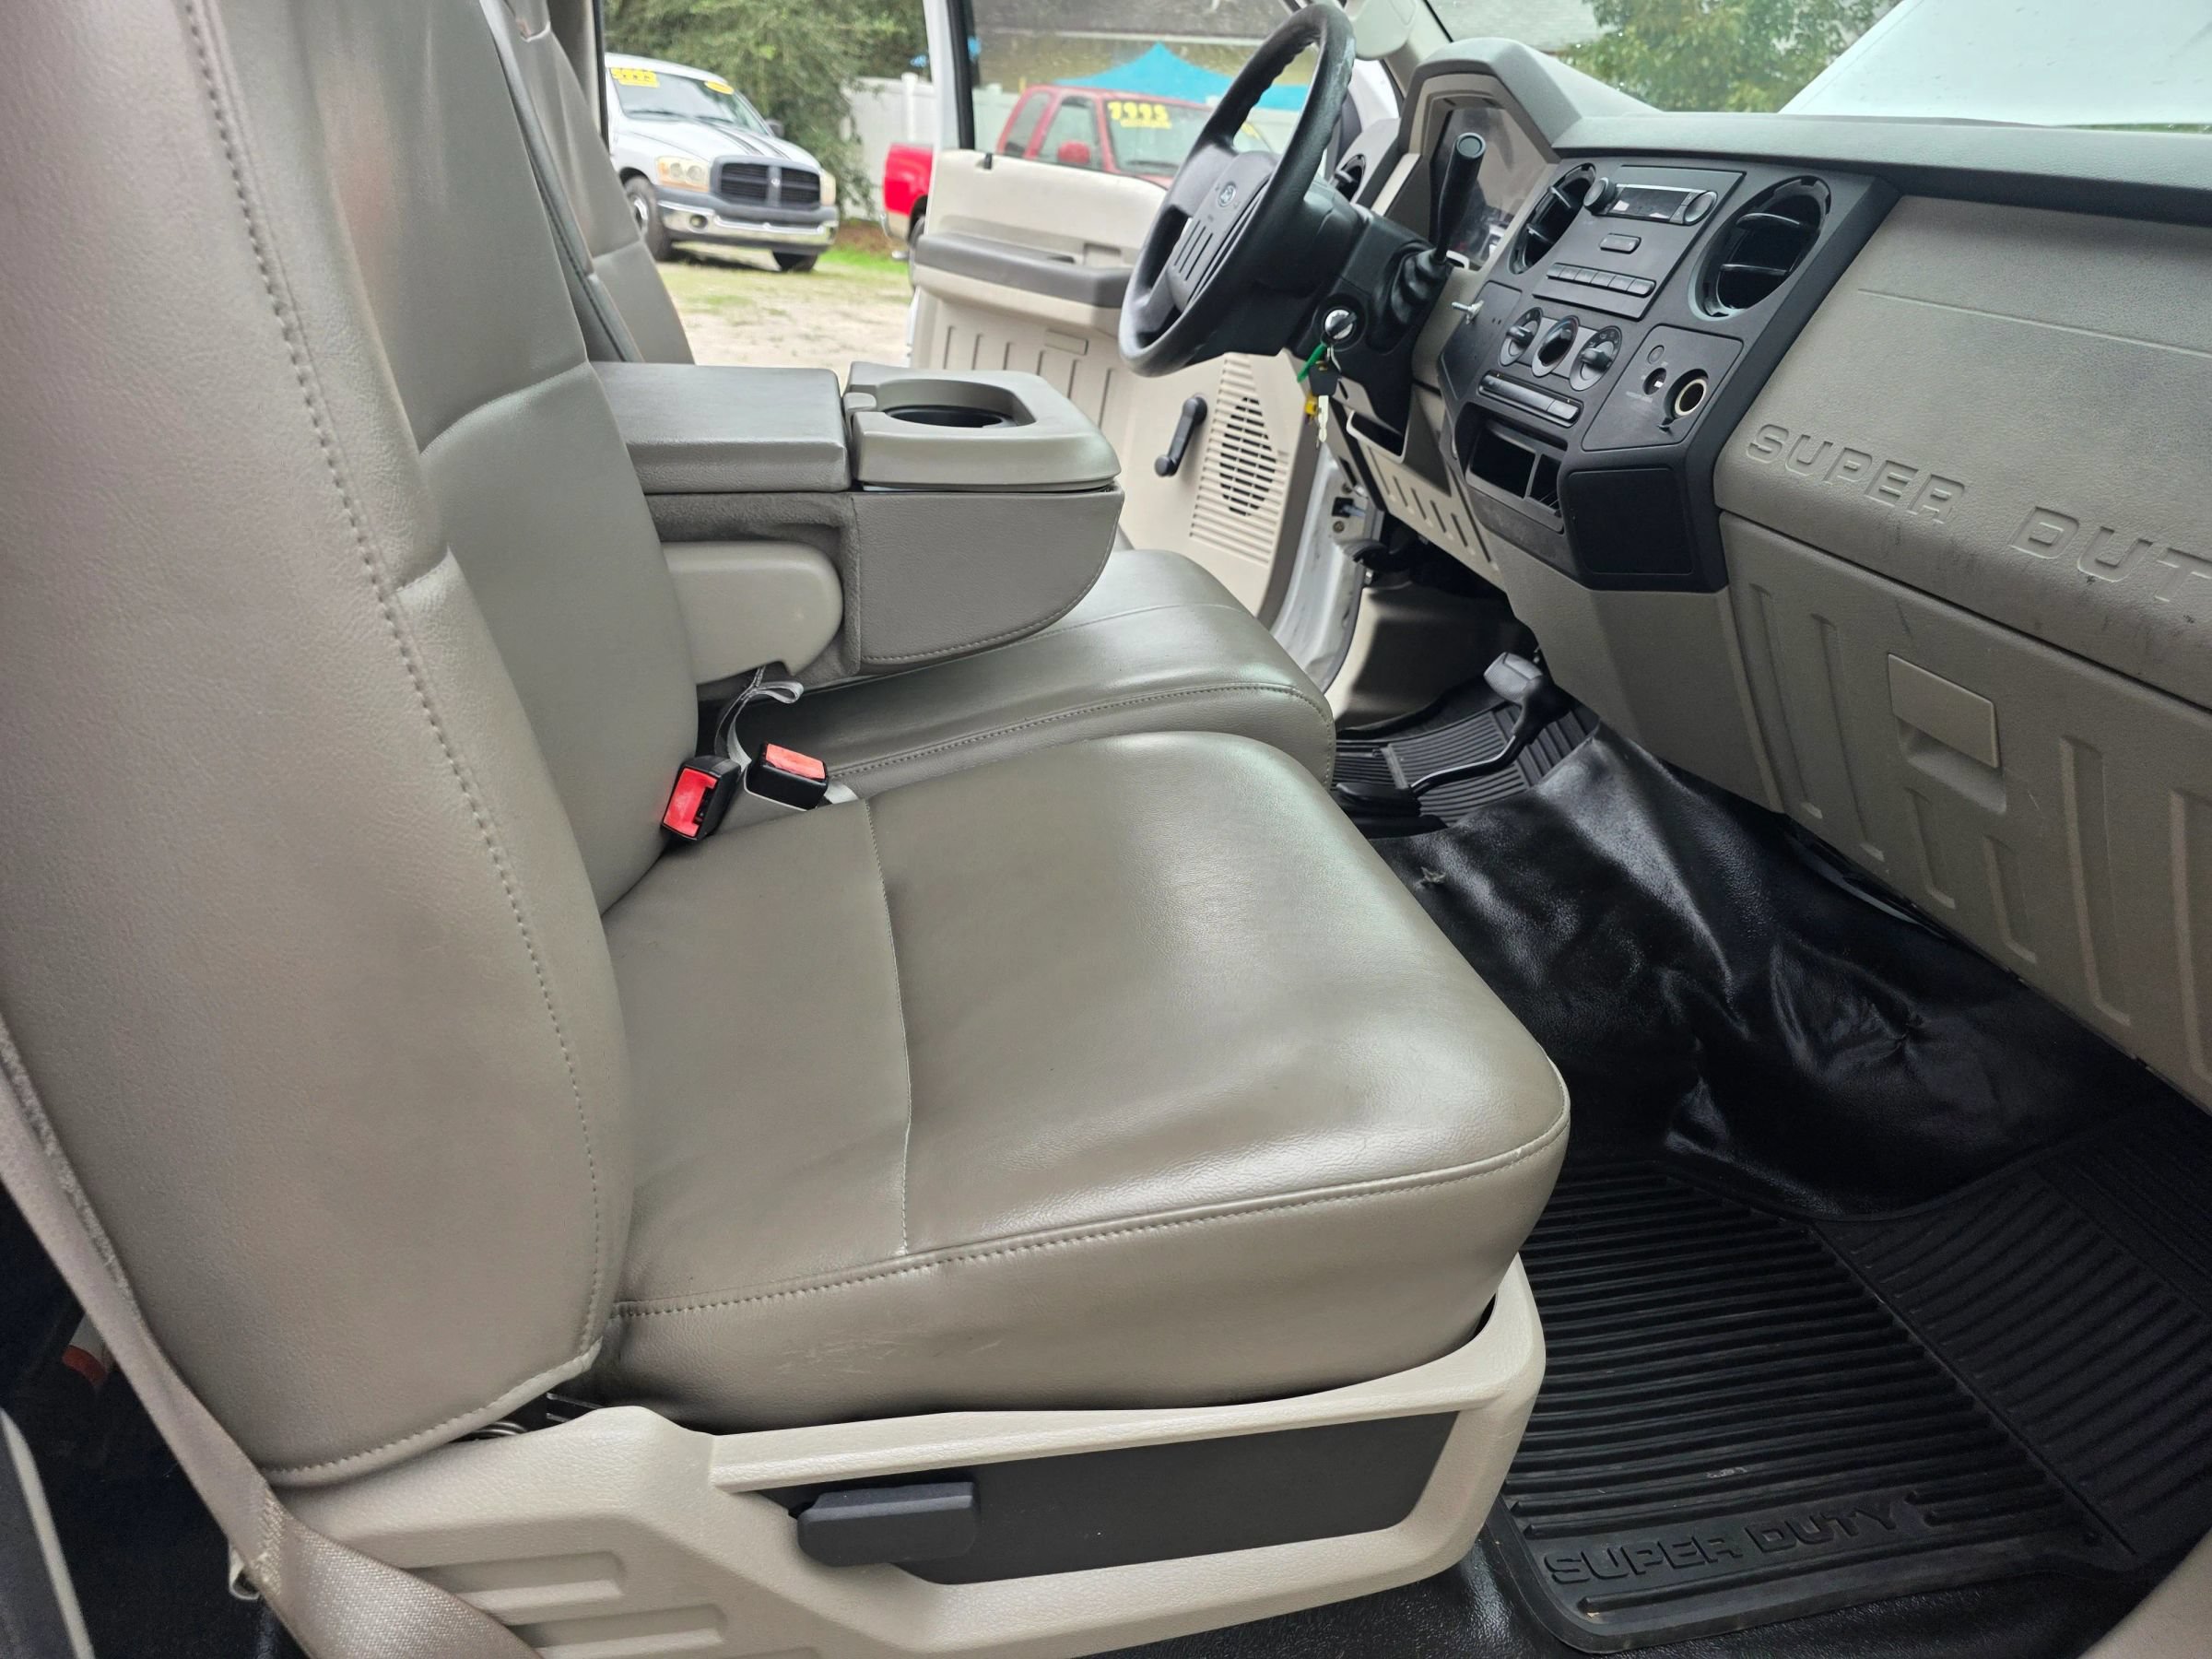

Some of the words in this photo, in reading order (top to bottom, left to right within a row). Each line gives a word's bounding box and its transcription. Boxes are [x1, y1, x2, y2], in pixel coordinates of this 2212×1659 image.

[1746, 423, 1966, 524] SUPER
[1543, 1534, 1744, 1585] SUPER
[1744, 1506, 1899, 1554] DUTY
